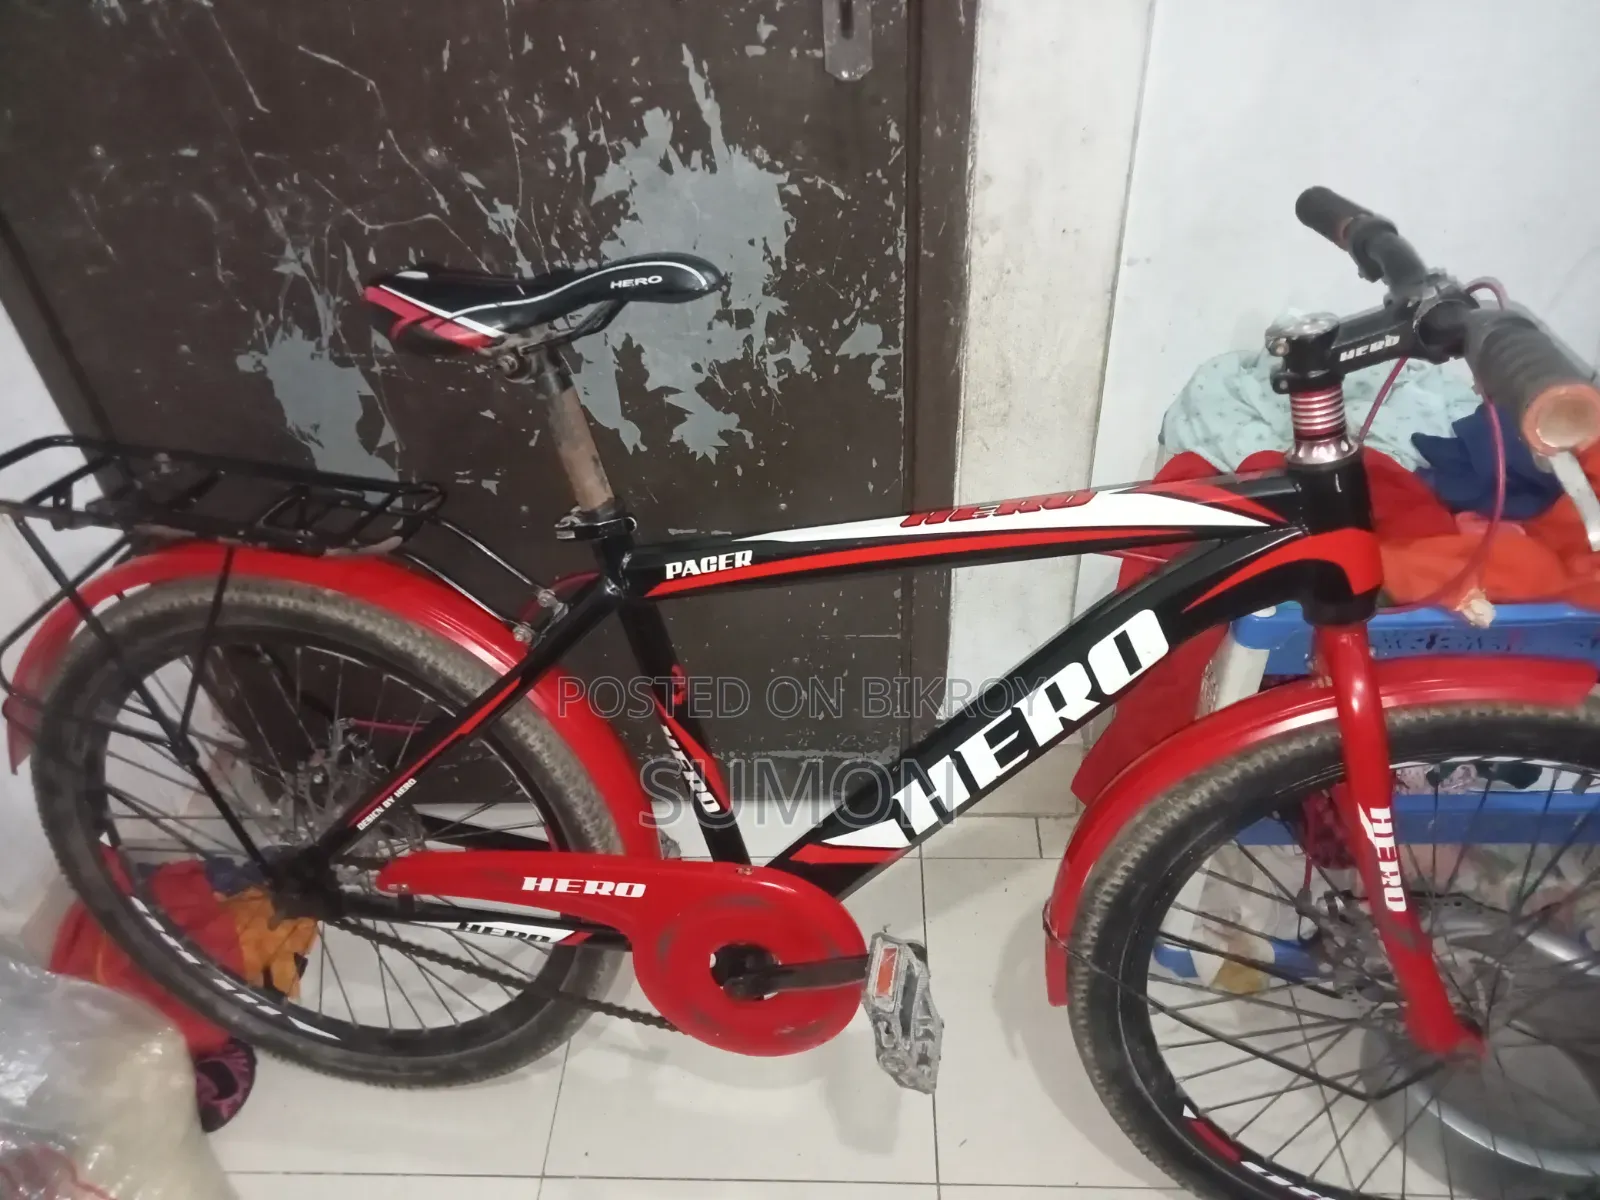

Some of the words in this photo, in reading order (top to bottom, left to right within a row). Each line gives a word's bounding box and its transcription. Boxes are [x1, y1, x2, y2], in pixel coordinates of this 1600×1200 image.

[610, 275, 663, 289] HERO
[1339, 334, 1400, 362] HERO
[900, 488, 1099, 528] HERO
[891, 608, 1170, 836] HERO
[382, 795, 396, 809] BY
[393, 777, 418, 798] HERO
[1369, 806, 1408, 912] HERO
[522, 876, 647, 898] HERO
